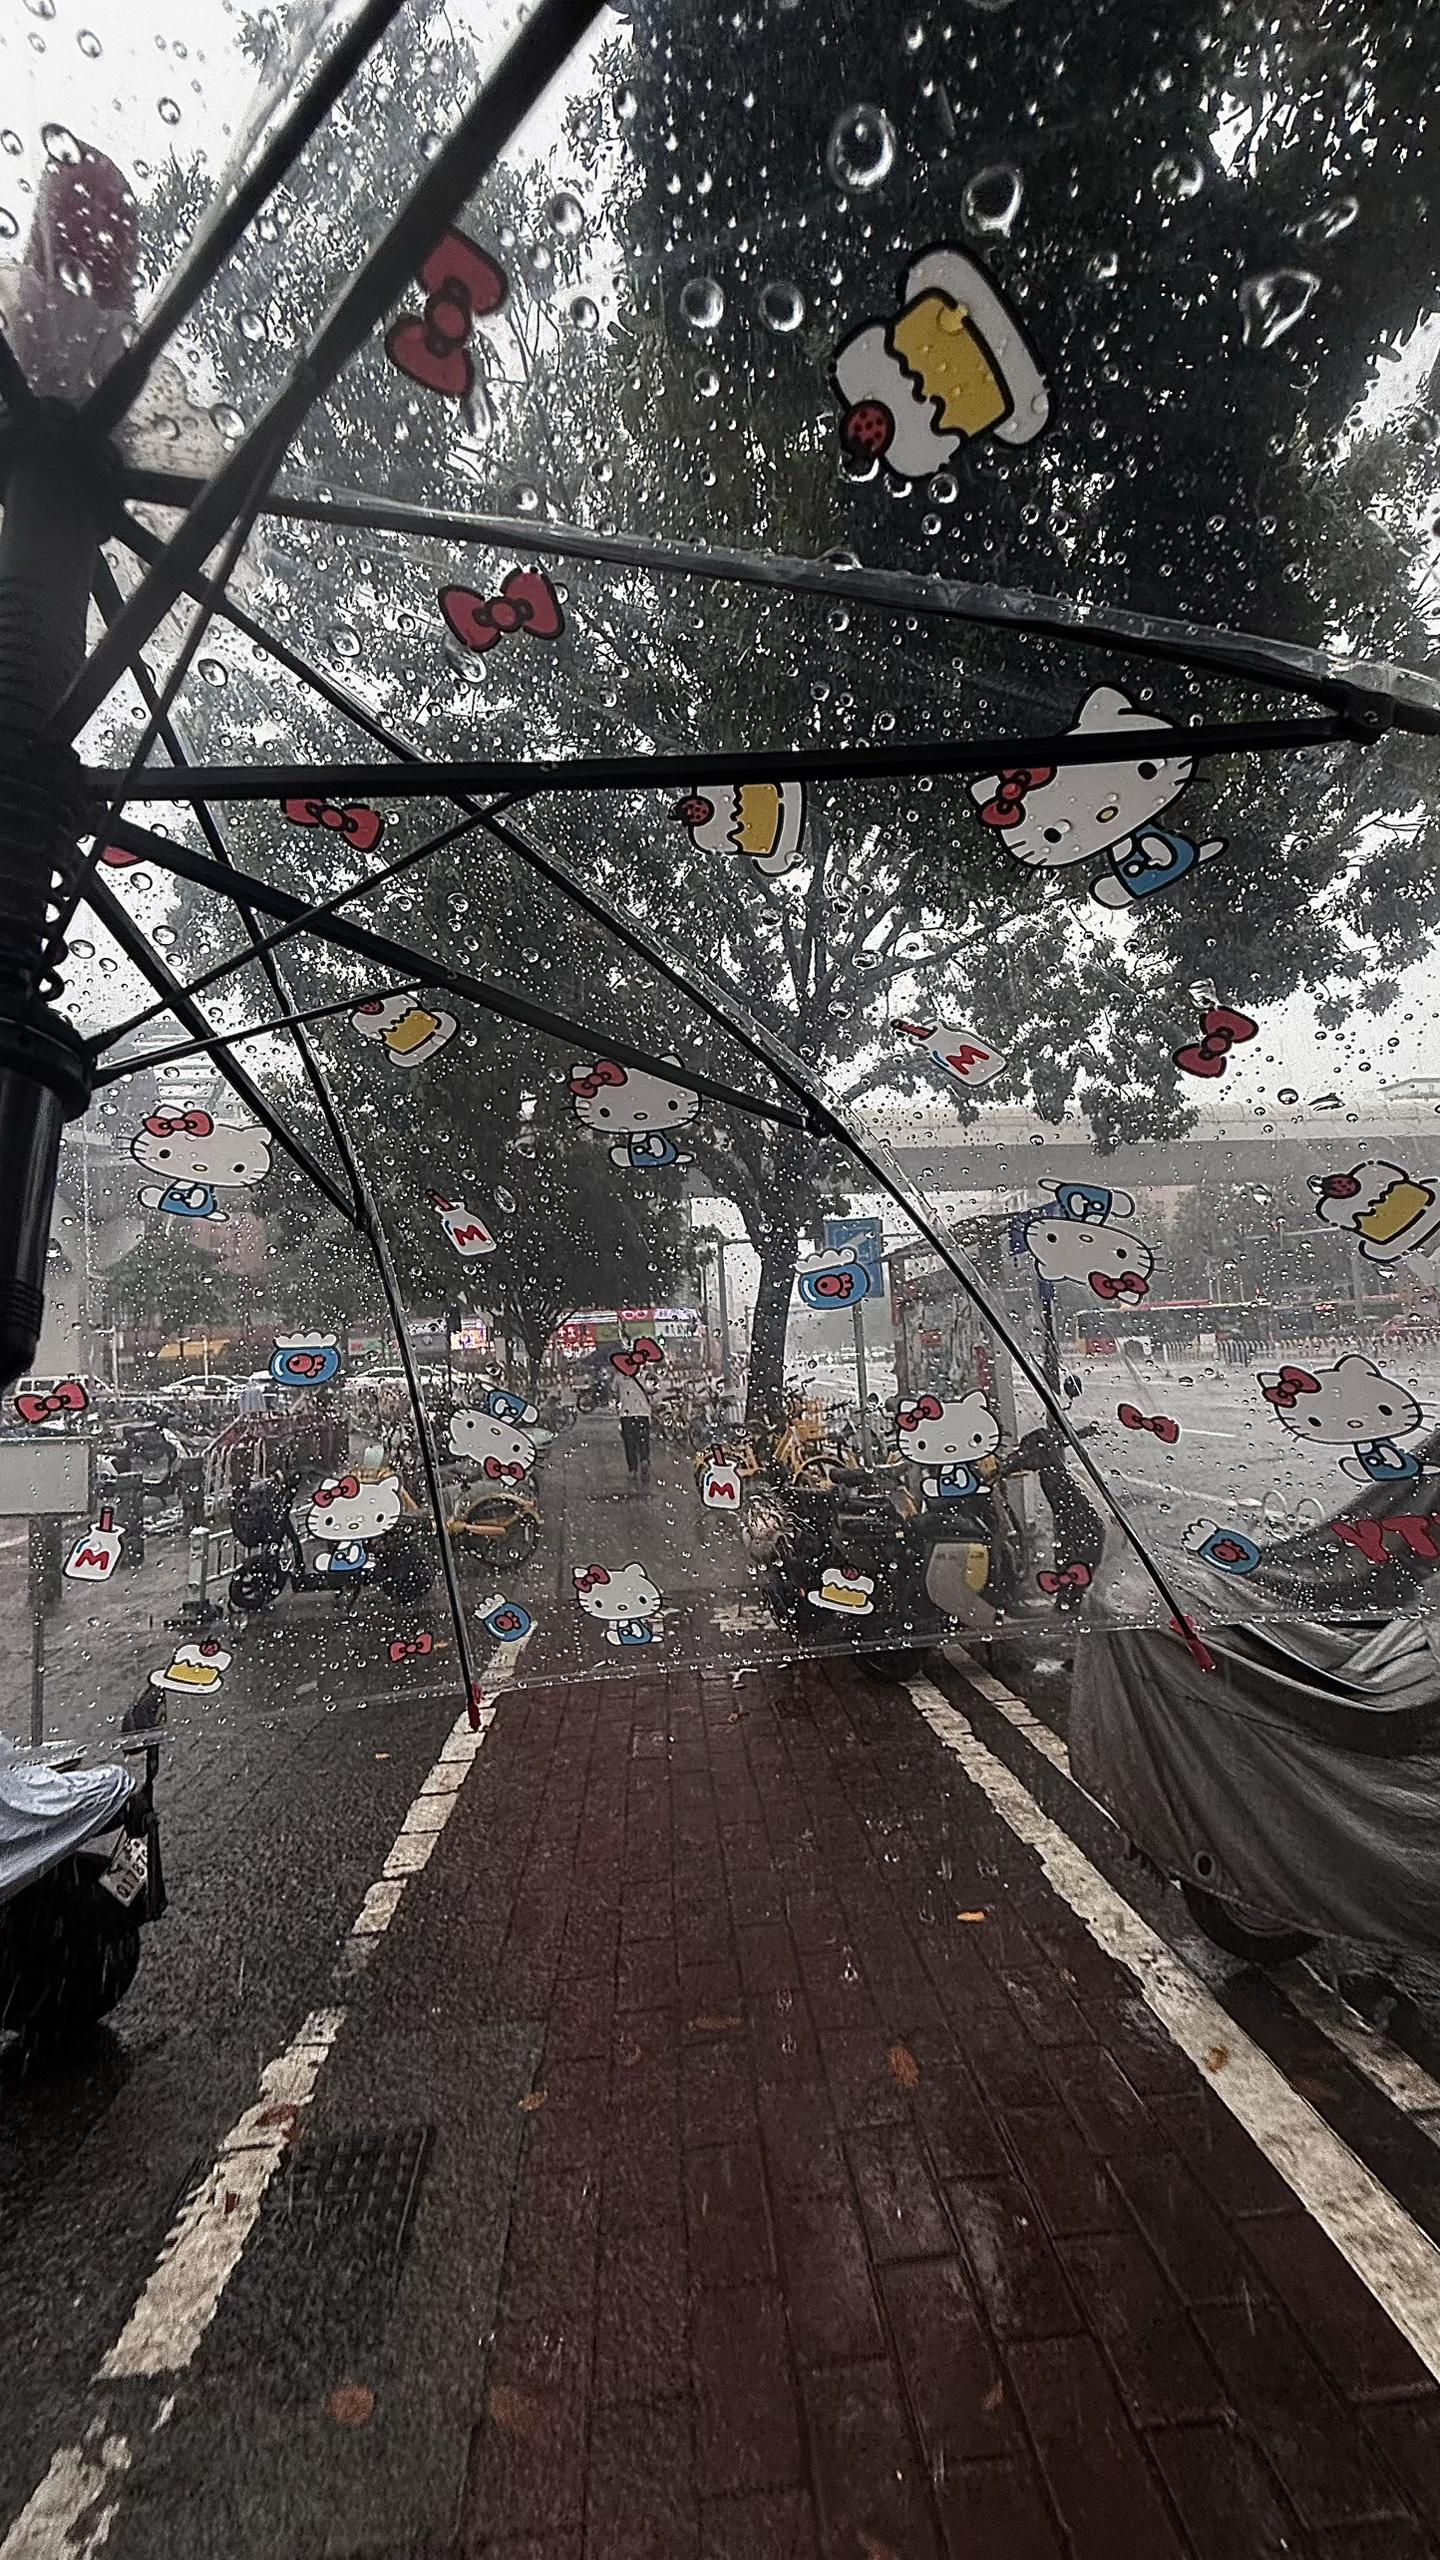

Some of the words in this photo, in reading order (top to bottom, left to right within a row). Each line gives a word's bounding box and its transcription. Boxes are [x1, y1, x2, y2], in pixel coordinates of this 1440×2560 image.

[946, 1044, 990, 1075] M
[453, 1224, 488, 1246] M
[708, 1481, 736, 1500] M
[74, 1548, 110, 1571] M
